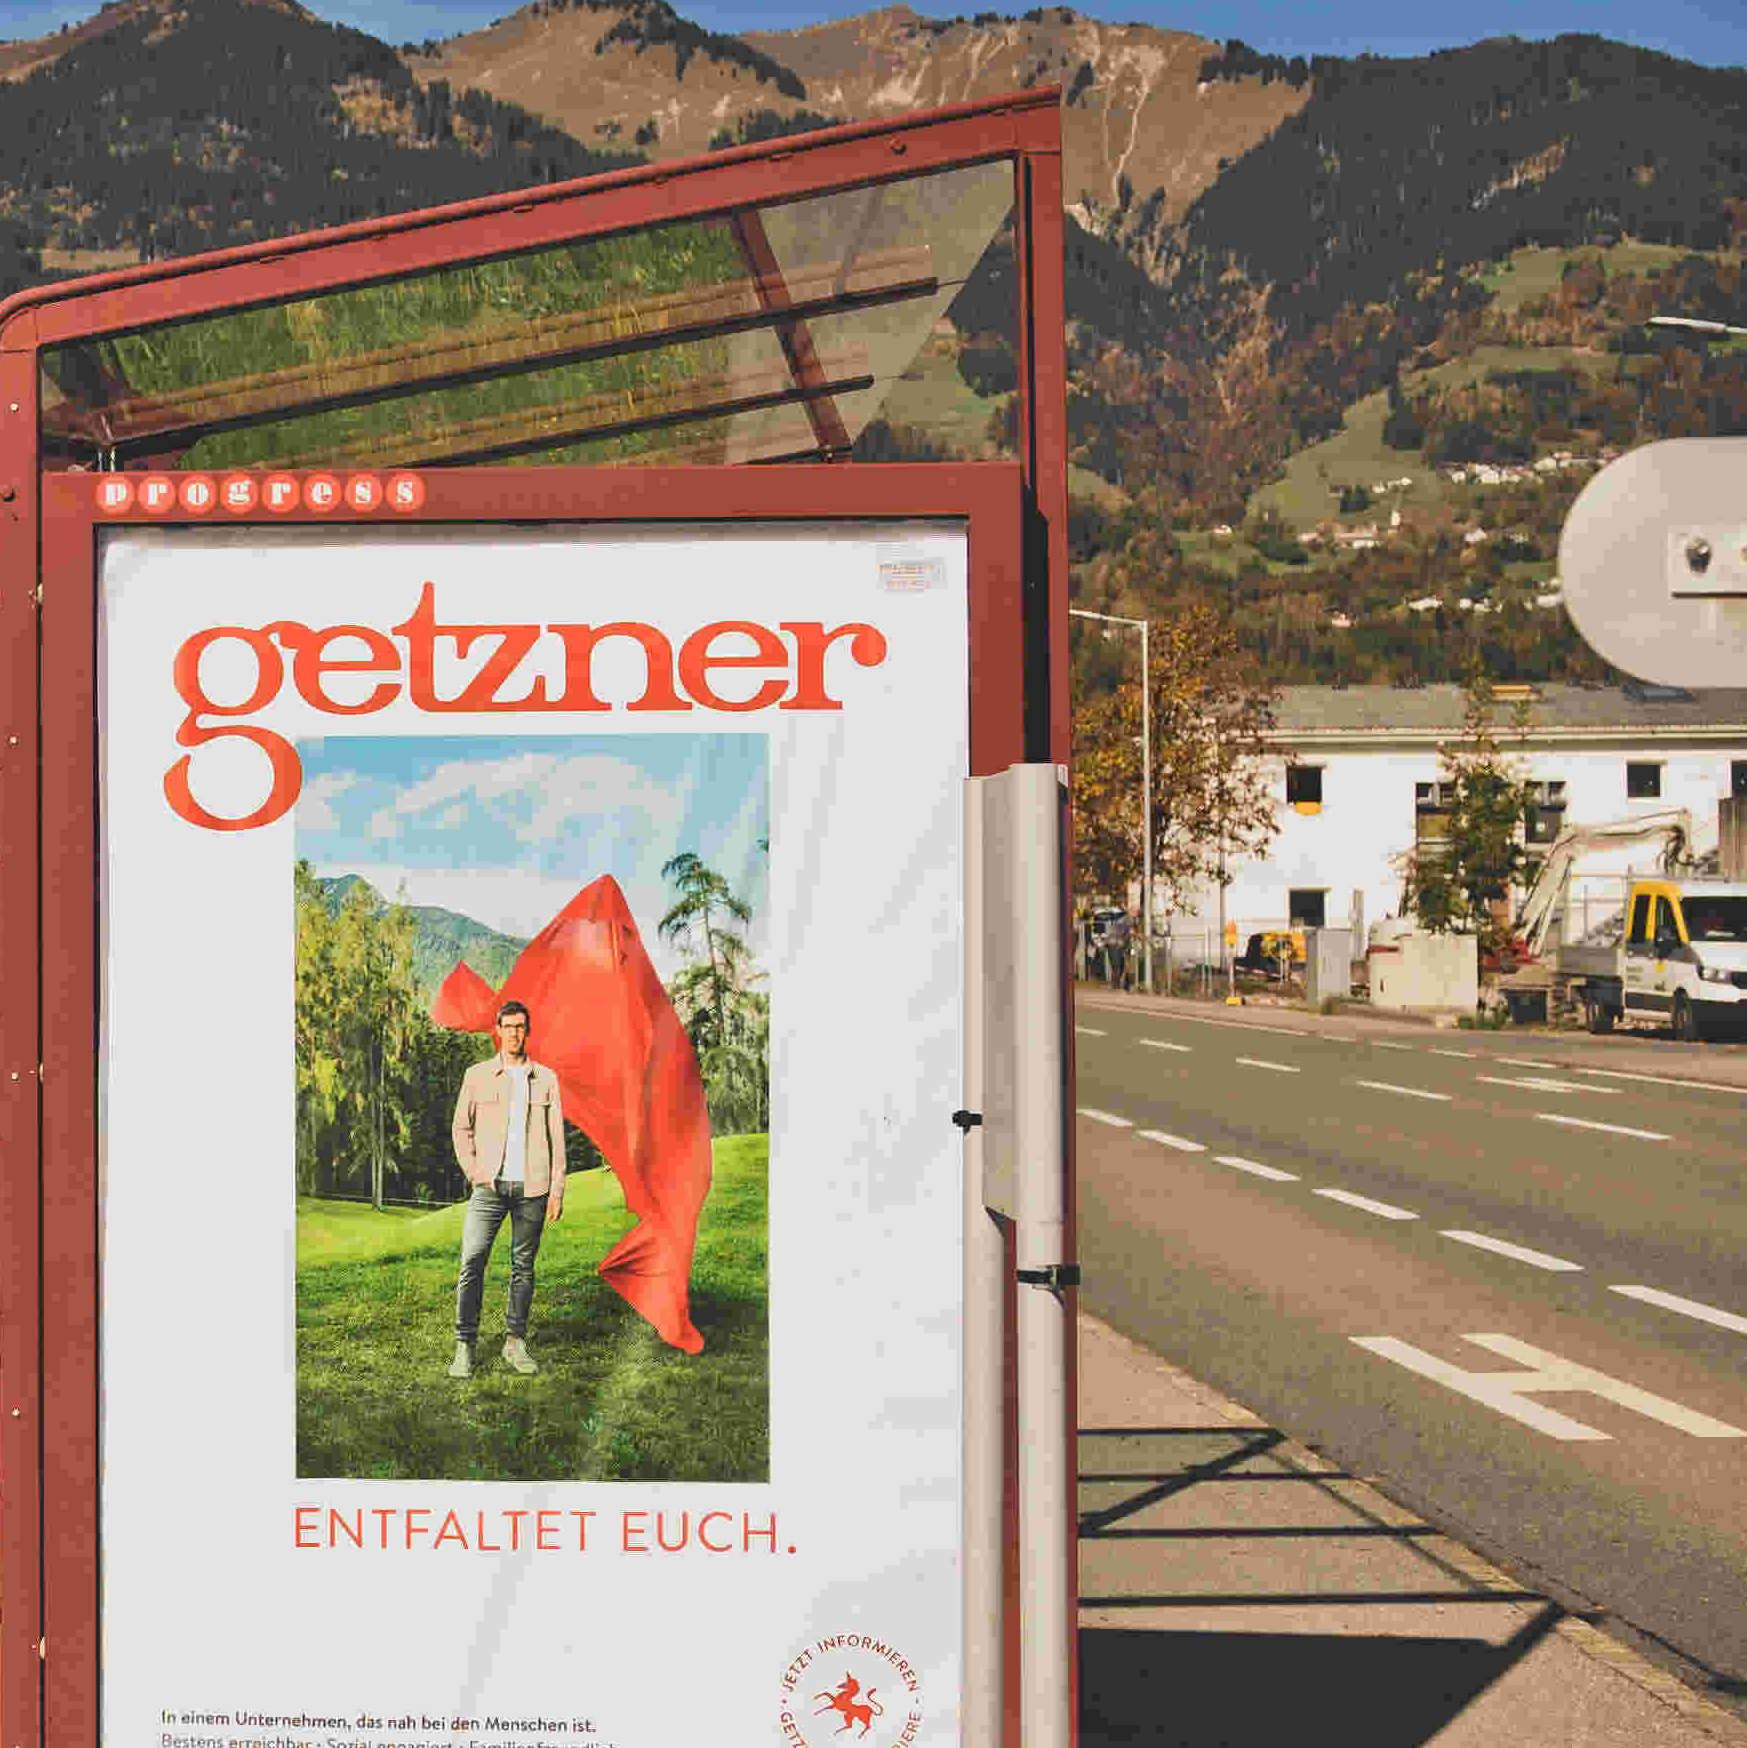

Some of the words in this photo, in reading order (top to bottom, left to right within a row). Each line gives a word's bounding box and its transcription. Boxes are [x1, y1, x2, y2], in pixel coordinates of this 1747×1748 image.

[102, 478, 417, 507] progress
[163, 581, 887, 831] getzner
[295, 1507, 597, 1551] ENTFALTET
[622, 1510, 797, 1555] EUCH.
[783, 1648, 813, 1693] JETZT
[817, 1634, 917, 1693] INFORMIEREN
[161, 1708, 176, 1725] In
[181, 1710, 230, 1726] einem
[235, 1711, 352, 1731] Unternehmen,
[356, 1713, 383, 1729] das
[387, 1714, 416, 1730] nah
[421, 1714, 446, 1730] bei
[451, 1716, 480, 1731] den
[484, 1716, 568, 1732] Menschen
[572, 1717, 597, 1733] ist.
[161, 1733, 224, 1748] Bestens
